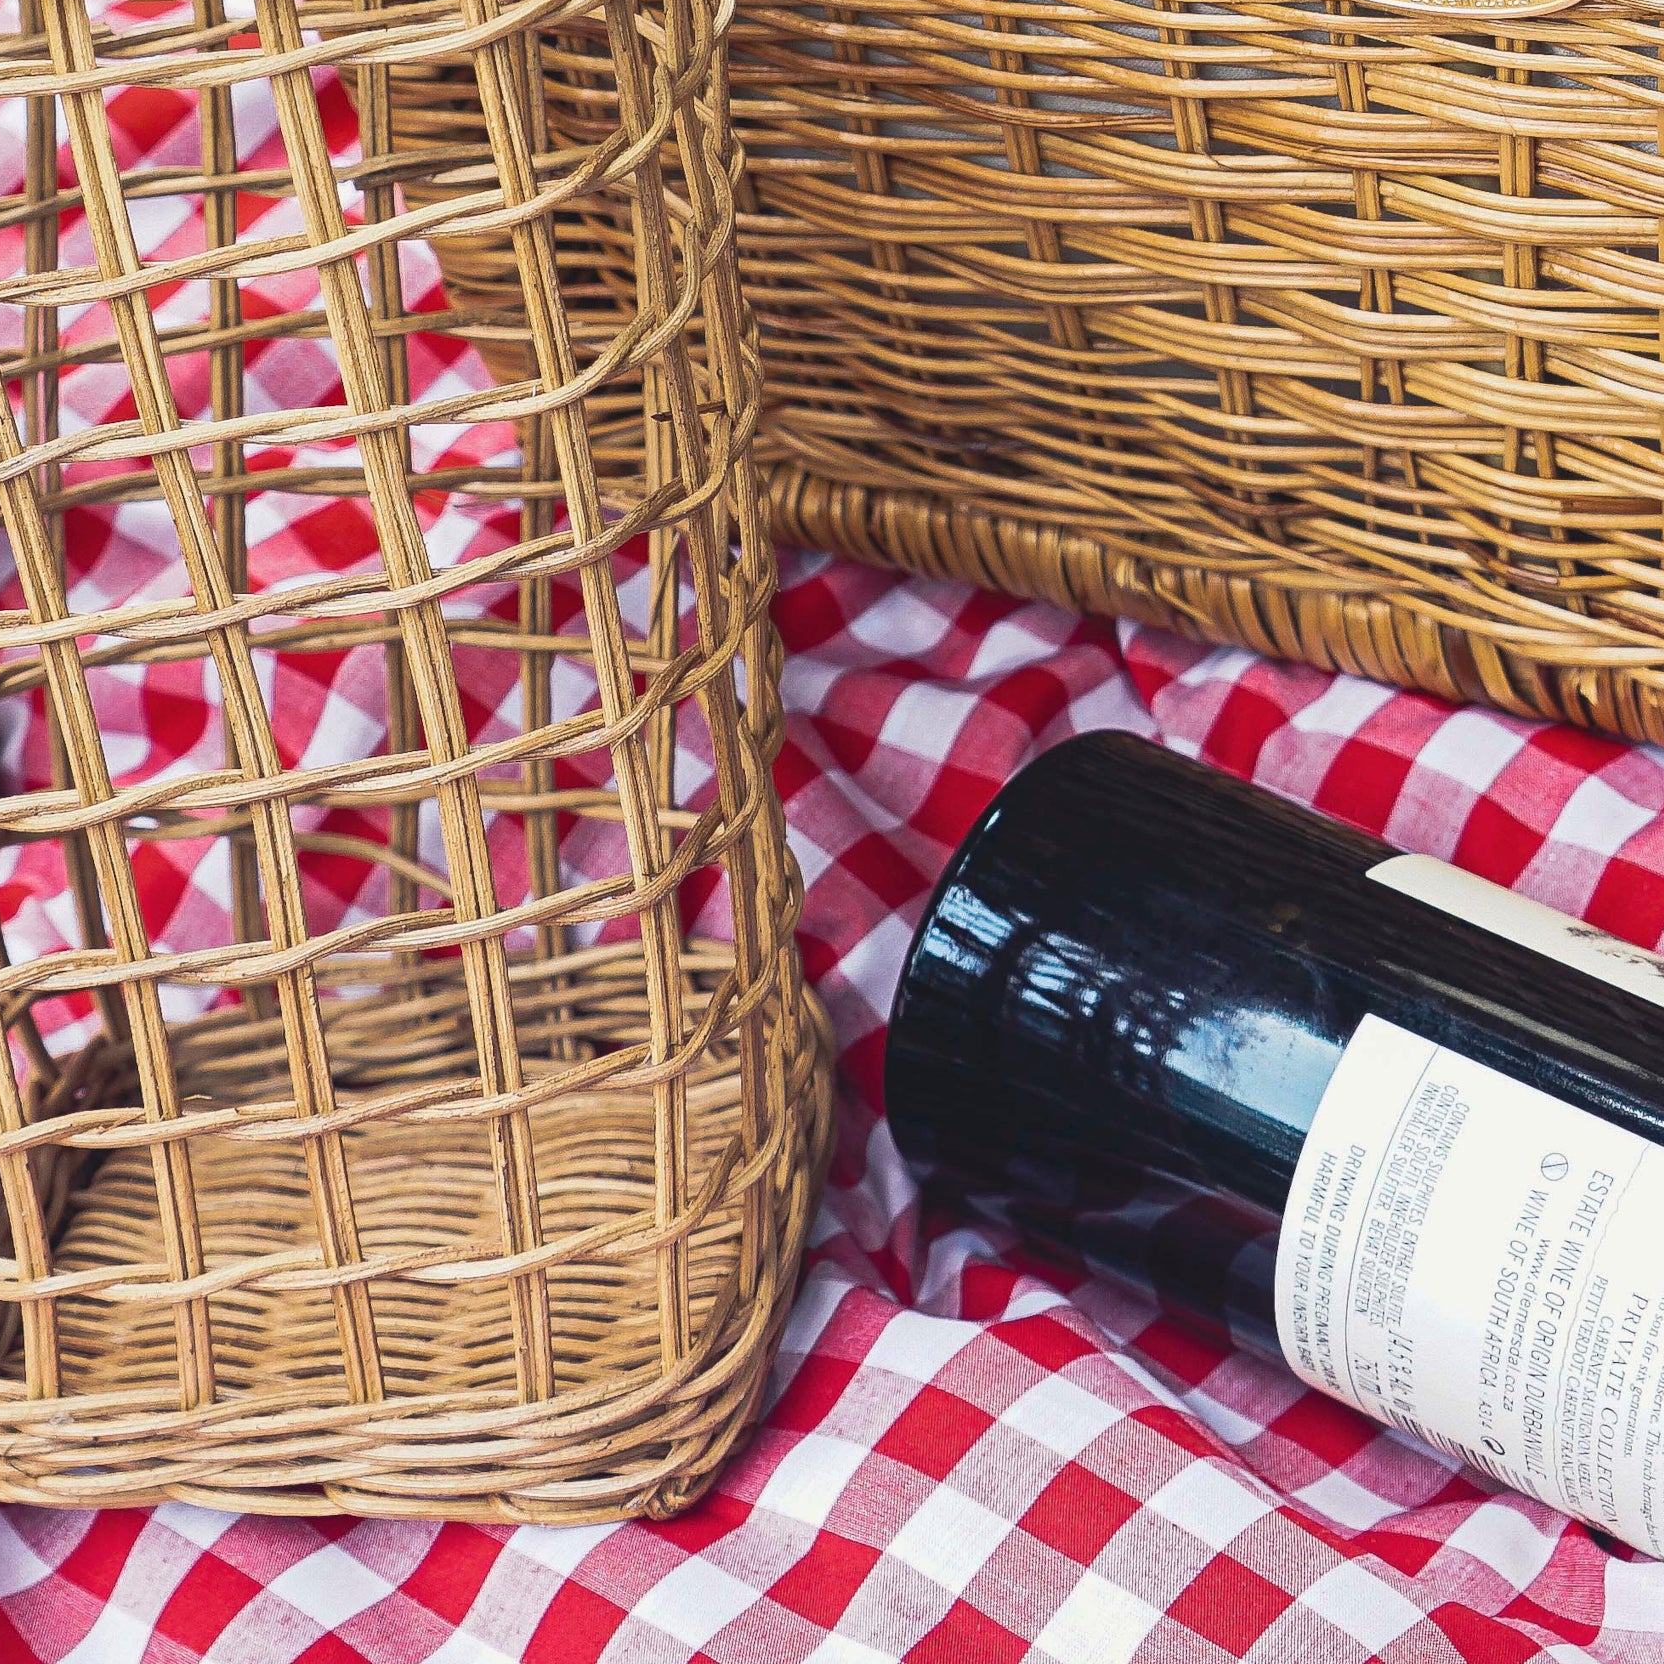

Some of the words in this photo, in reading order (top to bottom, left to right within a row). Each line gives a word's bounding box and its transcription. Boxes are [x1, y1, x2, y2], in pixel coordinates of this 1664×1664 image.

[1421, 1085, 1459, 1142] CONTIENE
[1433, 1103, 1470, 1160] CONTAINS
[1304, 1152, 1338, 1224] HARMFUL
[1330, 1145, 1366, 1222] DRINKING
[1373, 1154, 1407, 1210] SULFITER,
[1402, 1160, 1443, 1226] SULPHITES,
[1569, 1170, 1614, 1238] ESTATE
[1299, 1230, 1317, 1250] TO
[1364, 1218, 1385, 1258] BEVAT
[1379, 1192, 1412, 1268] INNEHOLDER
[1516, 1190, 1549, 1238] WINE
[1294, 1254, 1312, 1292] YOUR
[1318, 1224, 1341, 1283] DURING
[1507, 1240, 1528, 1267] OF
[1550, 1240, 1584, 1290] WINE
[1488, 1268, 1519, 1329] SOUTH
[1542, 1292, 1565, 1320] OF
[1585, 1275, 1608, 1318] PETIT
[1503, 1239, 1551, 1412] www.diemersdal.co.za
[1527, 1320, 1557, 1384] ORIGIN
[1568, 1319, 1595, 1375] VERDOT,
[1586, 1316, 1614, 1389] CABERNET
[1605, 1292, 1649, 1400] PRIVATE
[1642, 1340, 1659, 1363] for
[1649, 1314, 1663, 1337] son
[1479, 1329, 1503, 1388] AFRICA
[1636, 1364, 1651, 1384] six
[1523, 1382, 1547, 1480] DURBANVILLE
[1561, 1375, 1580, 1440] CABERNET
[1595, 1407, 1621, 1528] COLLECTION
[1643, 1459, 1656, 1481] rich
[1645, 1430, 1661, 1457] This
[1640, 1482, 1656, 1523] heritage
